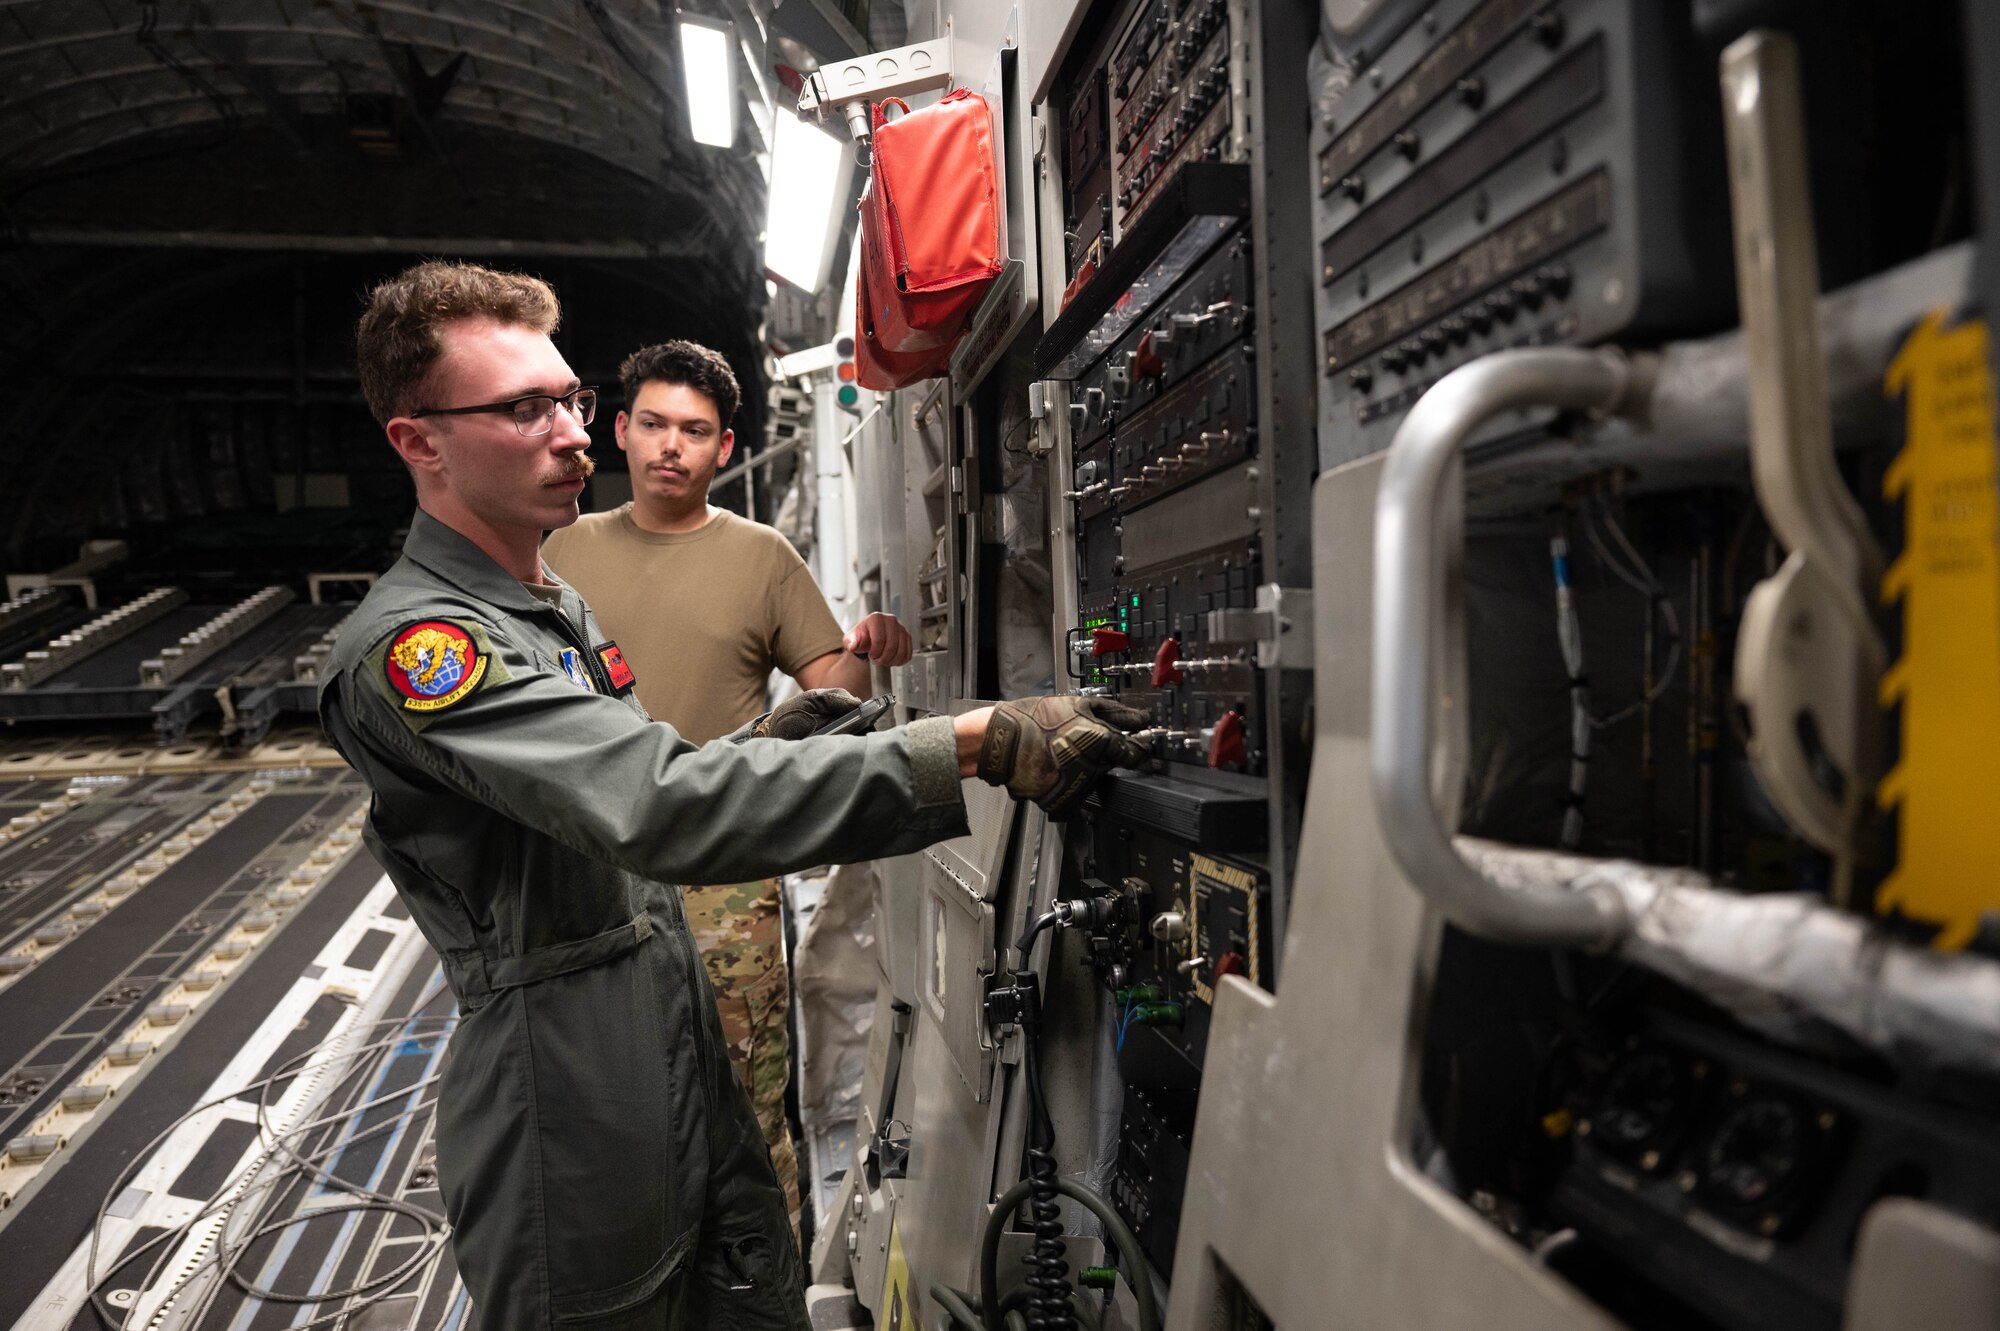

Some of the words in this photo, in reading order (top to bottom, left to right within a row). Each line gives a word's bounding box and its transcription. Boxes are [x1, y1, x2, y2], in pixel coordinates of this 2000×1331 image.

[407, 699, 431, 708] 535TH
[433, 690, 461, 708] AIRLIFT
[462, 655, 485, 691] SQUADRON
